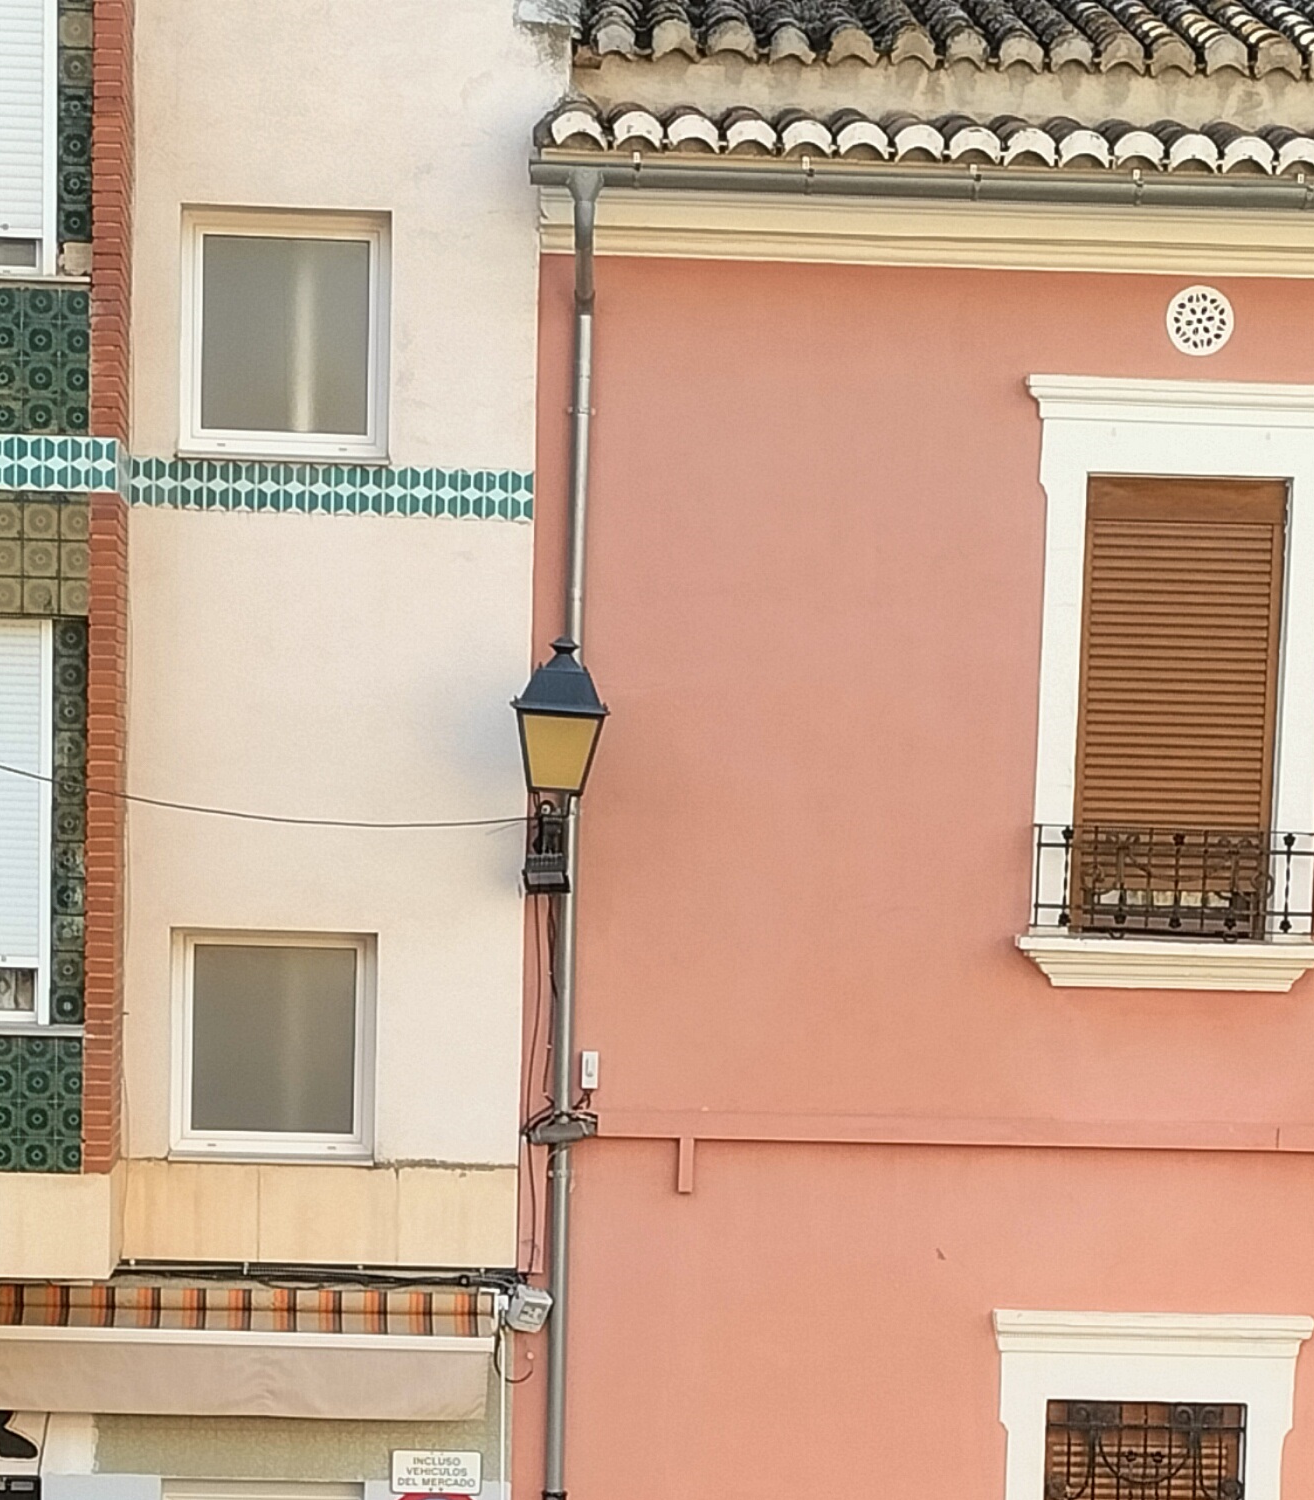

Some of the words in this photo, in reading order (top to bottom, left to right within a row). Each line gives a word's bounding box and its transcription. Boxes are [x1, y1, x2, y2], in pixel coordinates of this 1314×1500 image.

[413, 1457, 461, 1466] INCLUSO
[406, 1467, 468, 1477] VEHICULOS
[397, 1477, 418, 1486] DEL
[422, 1477, 476, 1488] MERCADO
